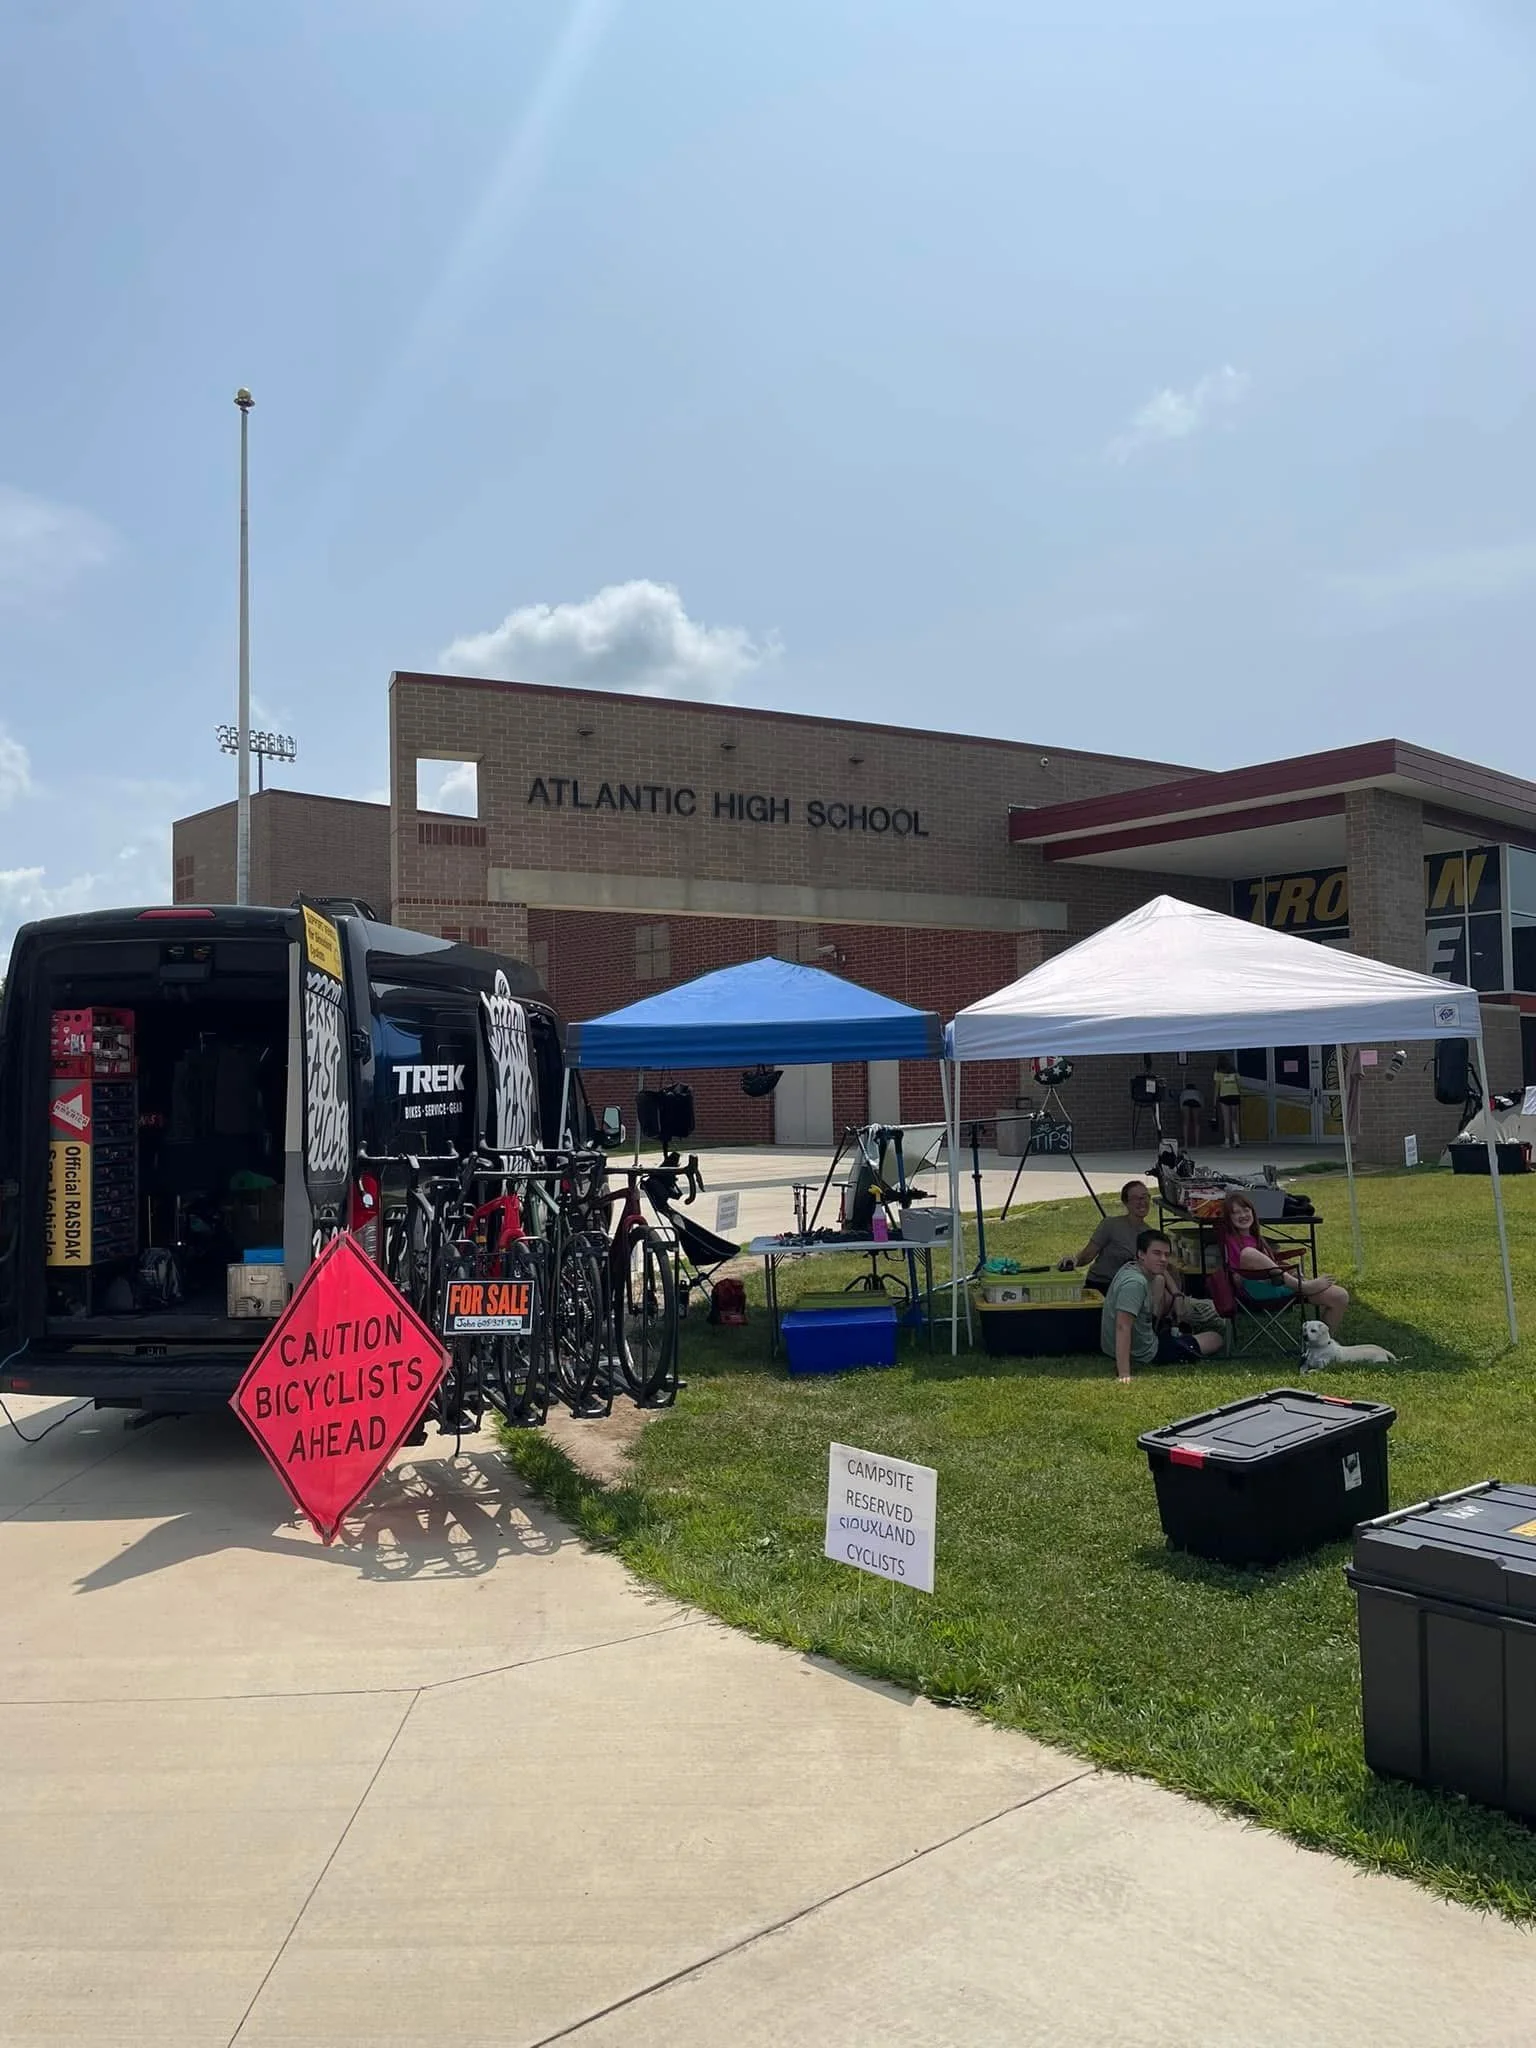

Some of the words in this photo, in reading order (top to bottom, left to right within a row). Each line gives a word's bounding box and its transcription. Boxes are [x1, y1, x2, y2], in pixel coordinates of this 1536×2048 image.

[527, 777, 697, 816] ATLANTIC
[713, 790, 790, 825] HIGH
[807, 800, 930, 837] SCHOOL
[392, 1064, 465, 1095] TREK
[404, 1105, 421, 1119] BIKES
[424, 1103, 447, 1117] SERVICE
[448, 1101, 463, 1114] GEAR
[1031, 1130, 1070, 1150] TIPS
[64, 1145, 81, 1196] Official
[64, 1200, 81, 1260] RASDAK
[449, 1284, 484, 1315] FOR
[486, 1283, 529, 1315] SALE
[280, 1311, 402, 1368] CAUTION
[255, 1356, 424, 1420] BICYCLISTS
[287, 1415, 386, 1464] AHEAD
[847, 1459, 915, 1493] CAMPSITE
[846, 1489, 913, 1524] RESERVED
[839, 1516, 916, 1546] SIOUXLAND
[846, 1543, 905, 1577] CYCLISTS
